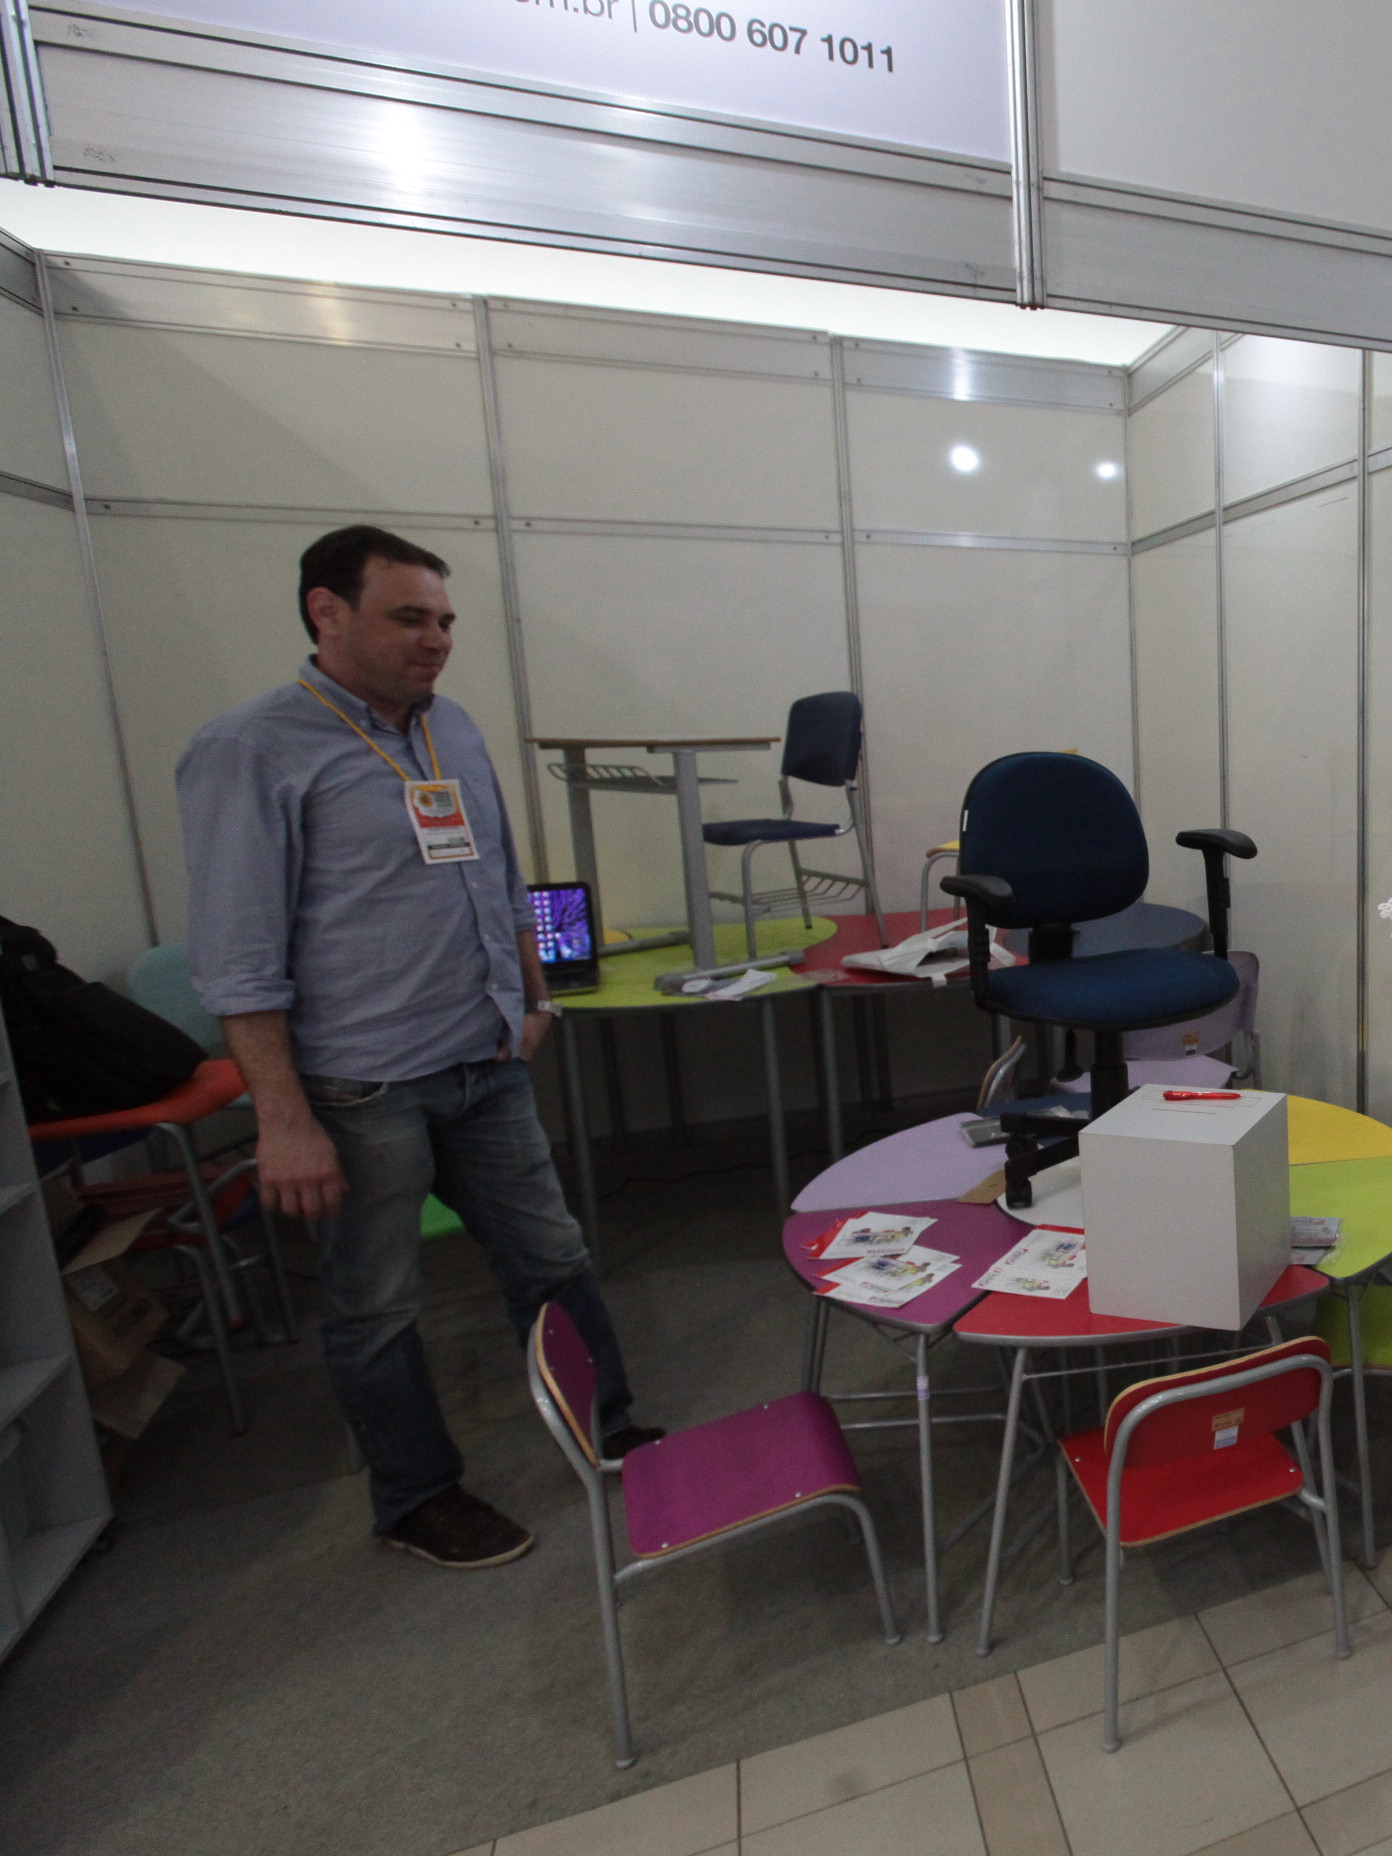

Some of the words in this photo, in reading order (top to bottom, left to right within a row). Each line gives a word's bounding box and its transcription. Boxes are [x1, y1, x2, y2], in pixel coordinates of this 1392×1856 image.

[648, 0, 737, 42] 0800
[746, 18, 808, 55] 607
[820, 34, 895, 73] 1011
